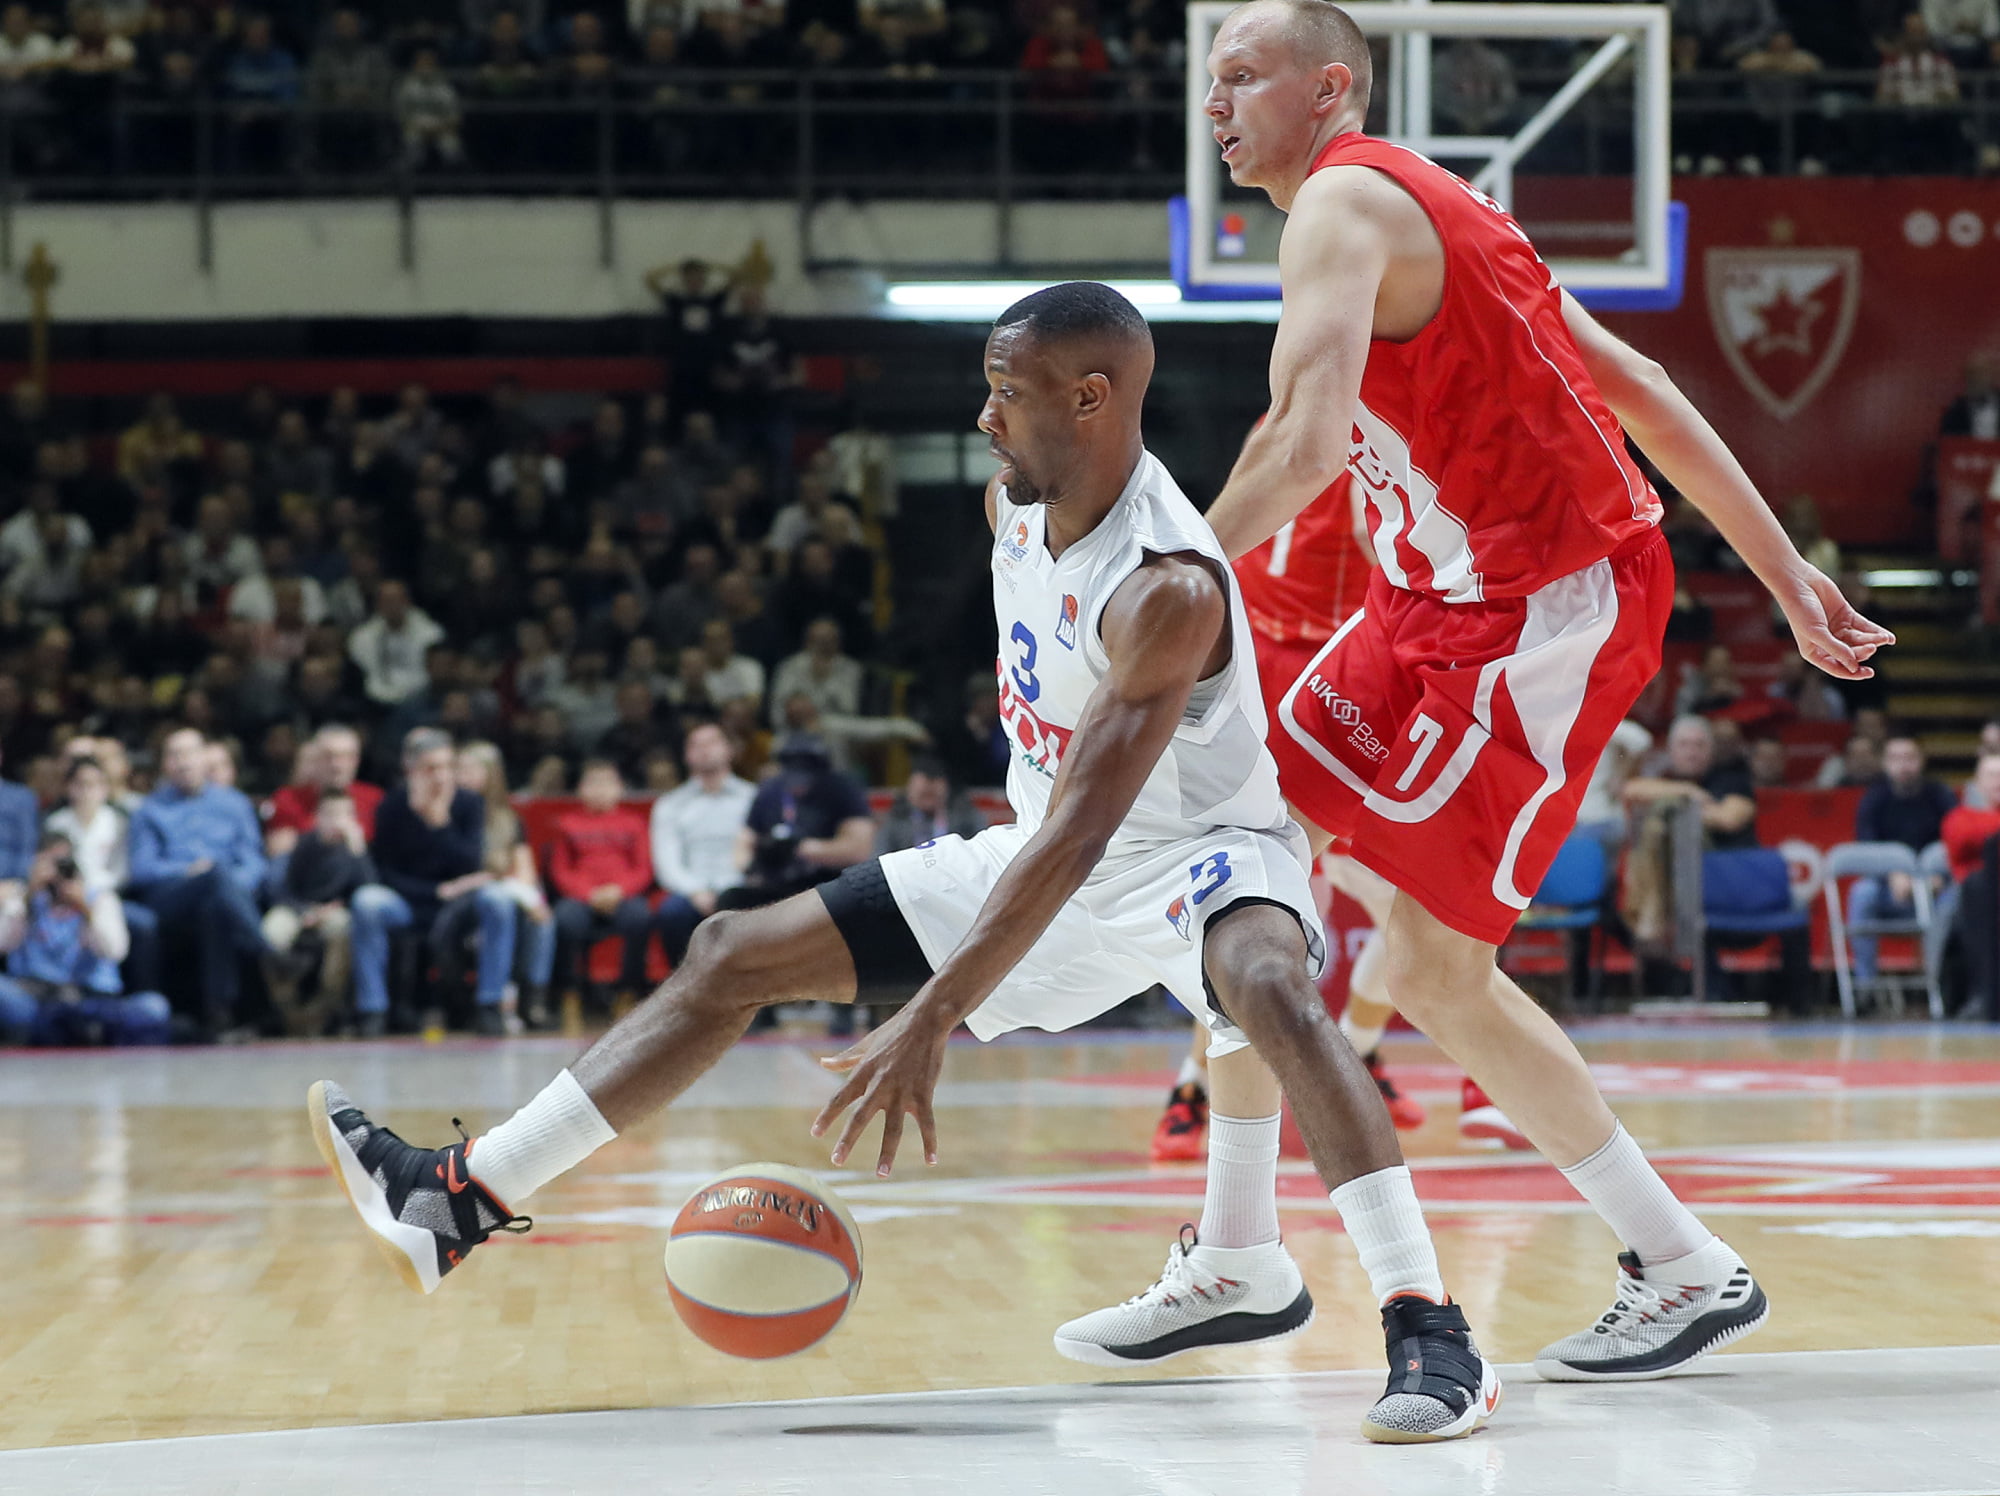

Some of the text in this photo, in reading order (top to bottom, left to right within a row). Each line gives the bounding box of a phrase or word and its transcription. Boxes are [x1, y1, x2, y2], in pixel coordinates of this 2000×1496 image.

[1056, 617, 1075, 647] ABA
[1011, 620, 1040, 703] 3
[1306, 674, 1340, 708] AIK
[1394, 711, 1444, 792] 7
[1190, 851, 1232, 906] 3
[691, 1186, 819, 1232] SPALDING
